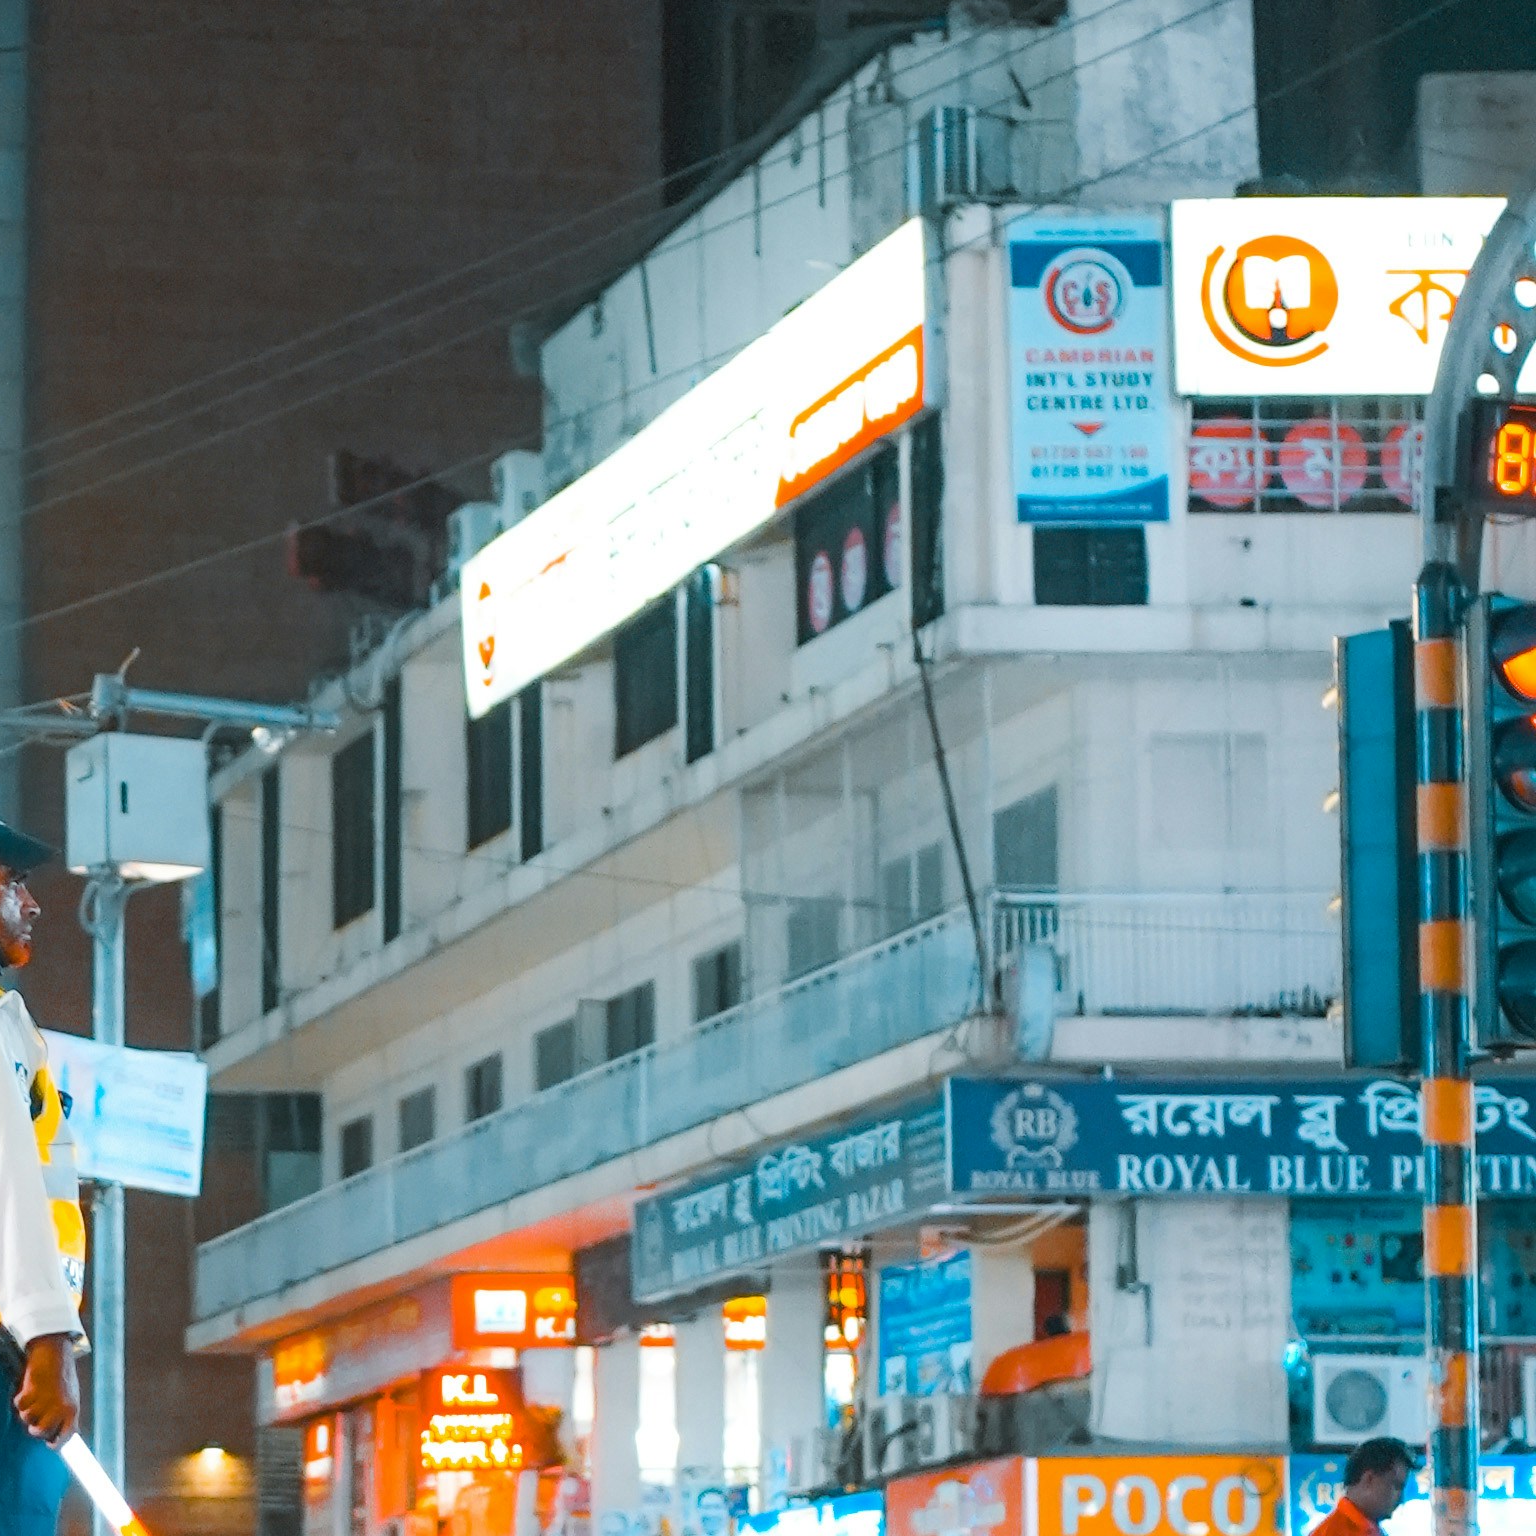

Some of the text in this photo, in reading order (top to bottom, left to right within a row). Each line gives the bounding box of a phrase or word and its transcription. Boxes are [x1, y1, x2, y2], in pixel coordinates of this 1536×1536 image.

[1025, 348, 1154, 363] CAMBRIAN
[1085, 372, 1153, 387] STUDY
[1027, 395, 1103, 410] CENTRE
[1015, 1108, 1058, 1138] RB
[1116, 1094, 1280, 1137] রয়েল
[1293, 1094, 1349, 1152] ব্লু
[1116, 1154, 1250, 1192] ROYAL
[1269, 1154, 1370, 1192] BLUE
